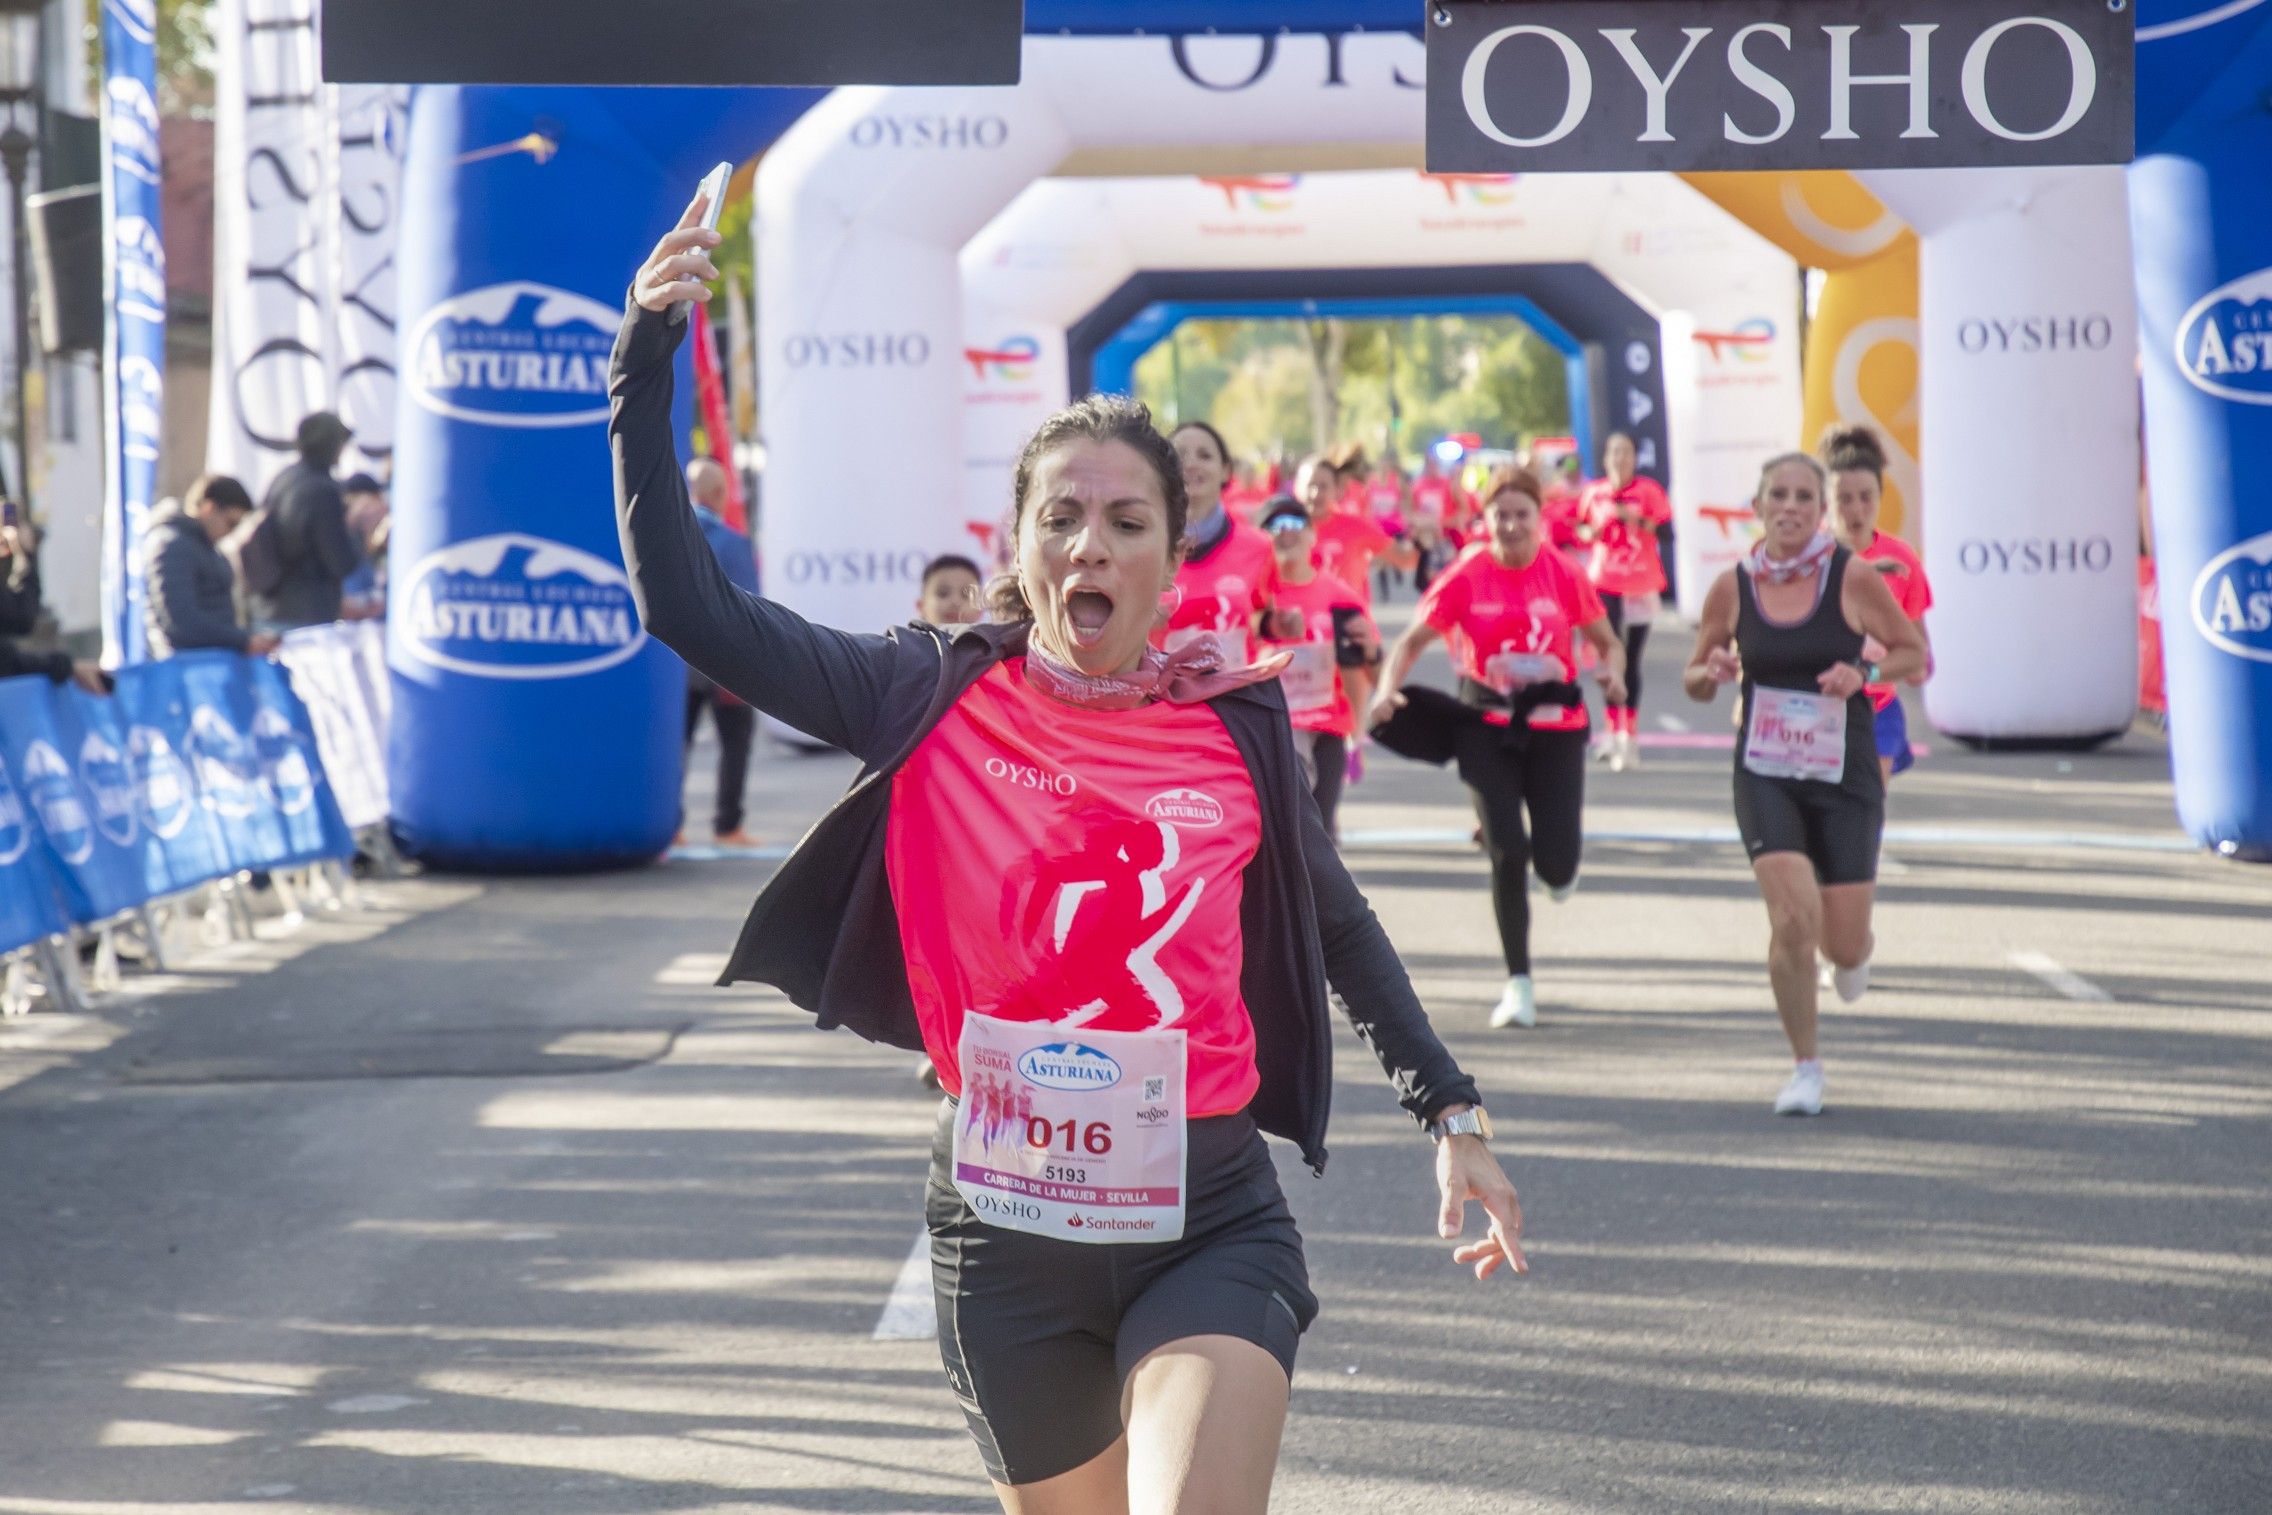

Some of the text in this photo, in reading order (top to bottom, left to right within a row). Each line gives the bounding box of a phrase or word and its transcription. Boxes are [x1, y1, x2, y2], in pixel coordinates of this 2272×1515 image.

[1462, 16, 2096, 147] OYSHO
[851, 115, 1008, 149] OYSHO
[784, 333, 931, 369] OYSHO
[1958, 312, 2112, 355] OYSHO
[784, 548, 928, 585] OYSHO
[1958, 535, 2112, 575] OYSHO
[411, 581, 633, 648] ASTURIANA
[985, 757, 1077, 797] OYSHO
[1153, 800, 1218, 821] ASTURIANA
[974, 1053, 1012, 1073] SUMA
[1026, 1055, 1113, 1082] ASTURIANA
[1026, 1115, 1113, 1155] 016
[983, 1172, 1150, 1204] CARRERA DE LA MUJER SEVILLA
[1045, 1165, 1087, 1184] 5193
[975, 1193, 1041, 1221] OYSHO
[1085, 1216, 1157, 1231] Santander
